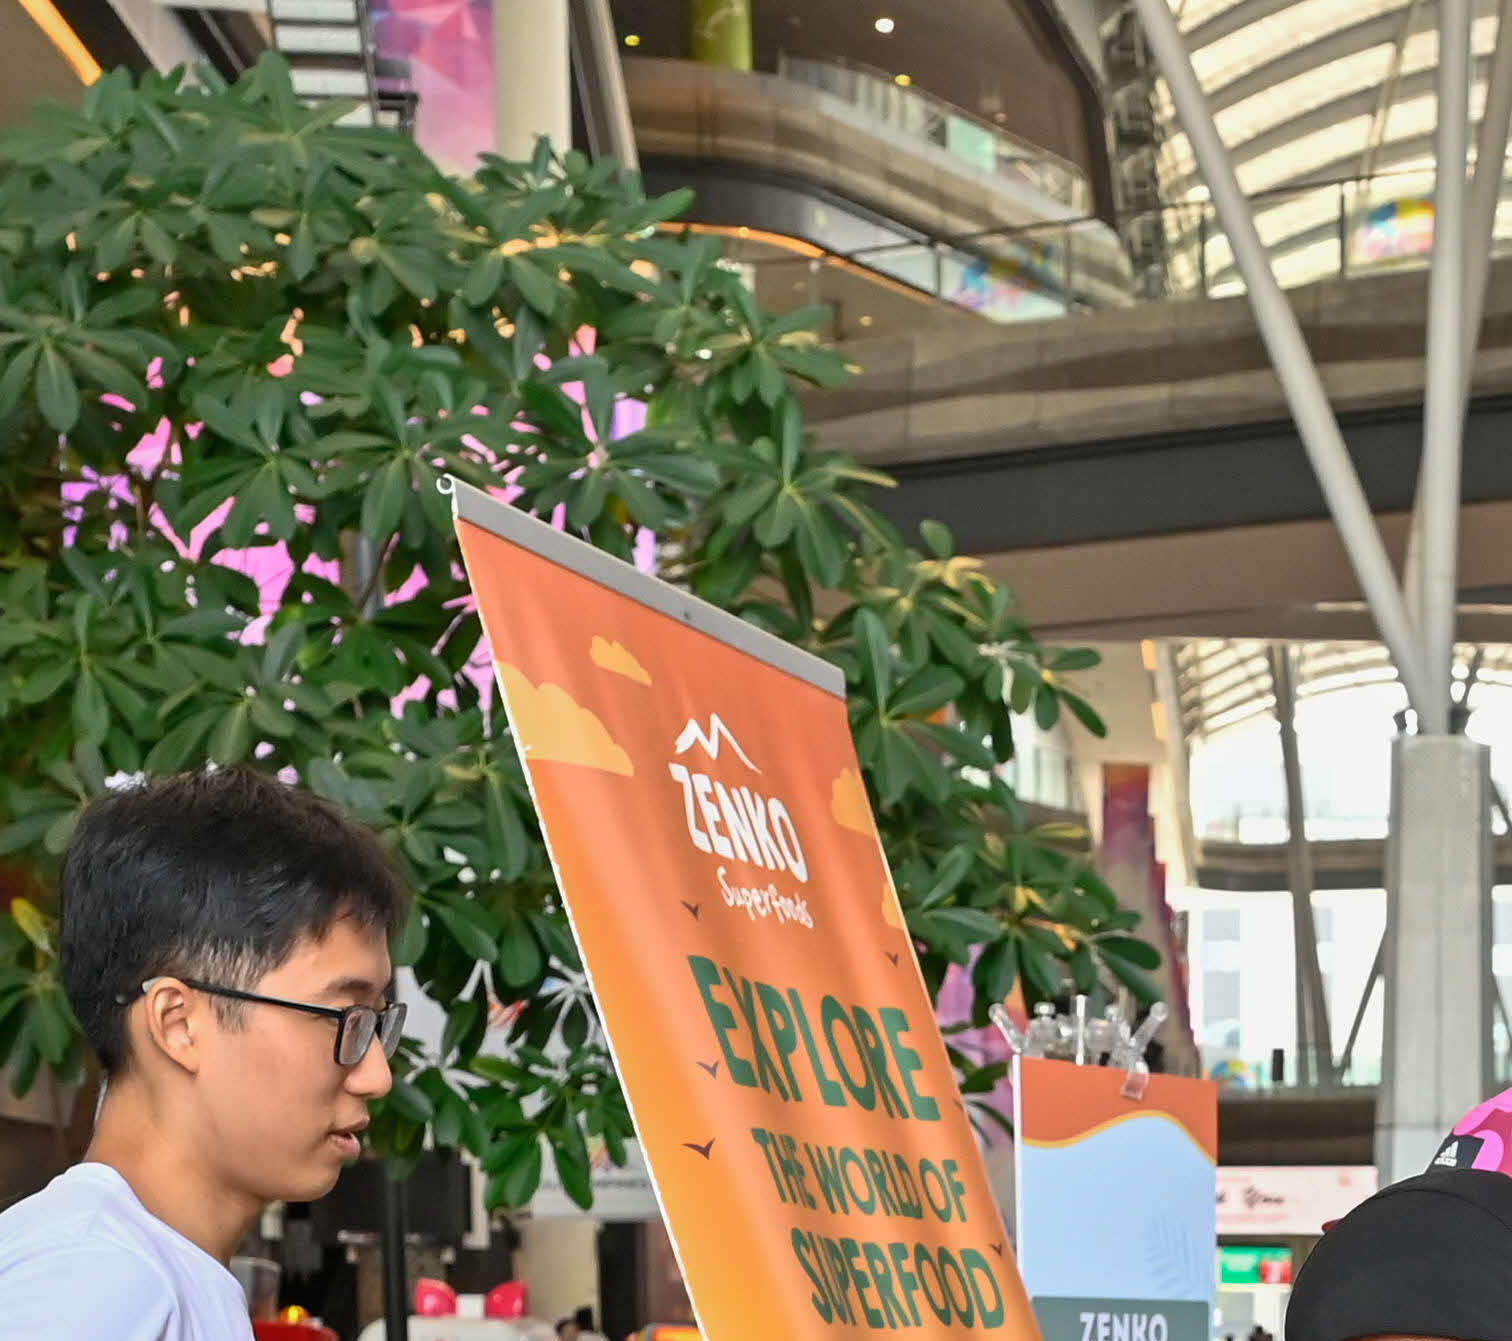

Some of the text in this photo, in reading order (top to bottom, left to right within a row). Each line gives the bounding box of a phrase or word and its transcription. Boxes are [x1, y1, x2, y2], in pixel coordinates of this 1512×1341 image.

[668, 762, 808, 884] ZENKO
[716, 865, 814, 929] Superfoods
[687, 954, 941, 1122] EXPLORE
[752, 1127, 967, 1223] THE WORLD OF
[791, 1227, 1006, 1331] SUPERFOOD
